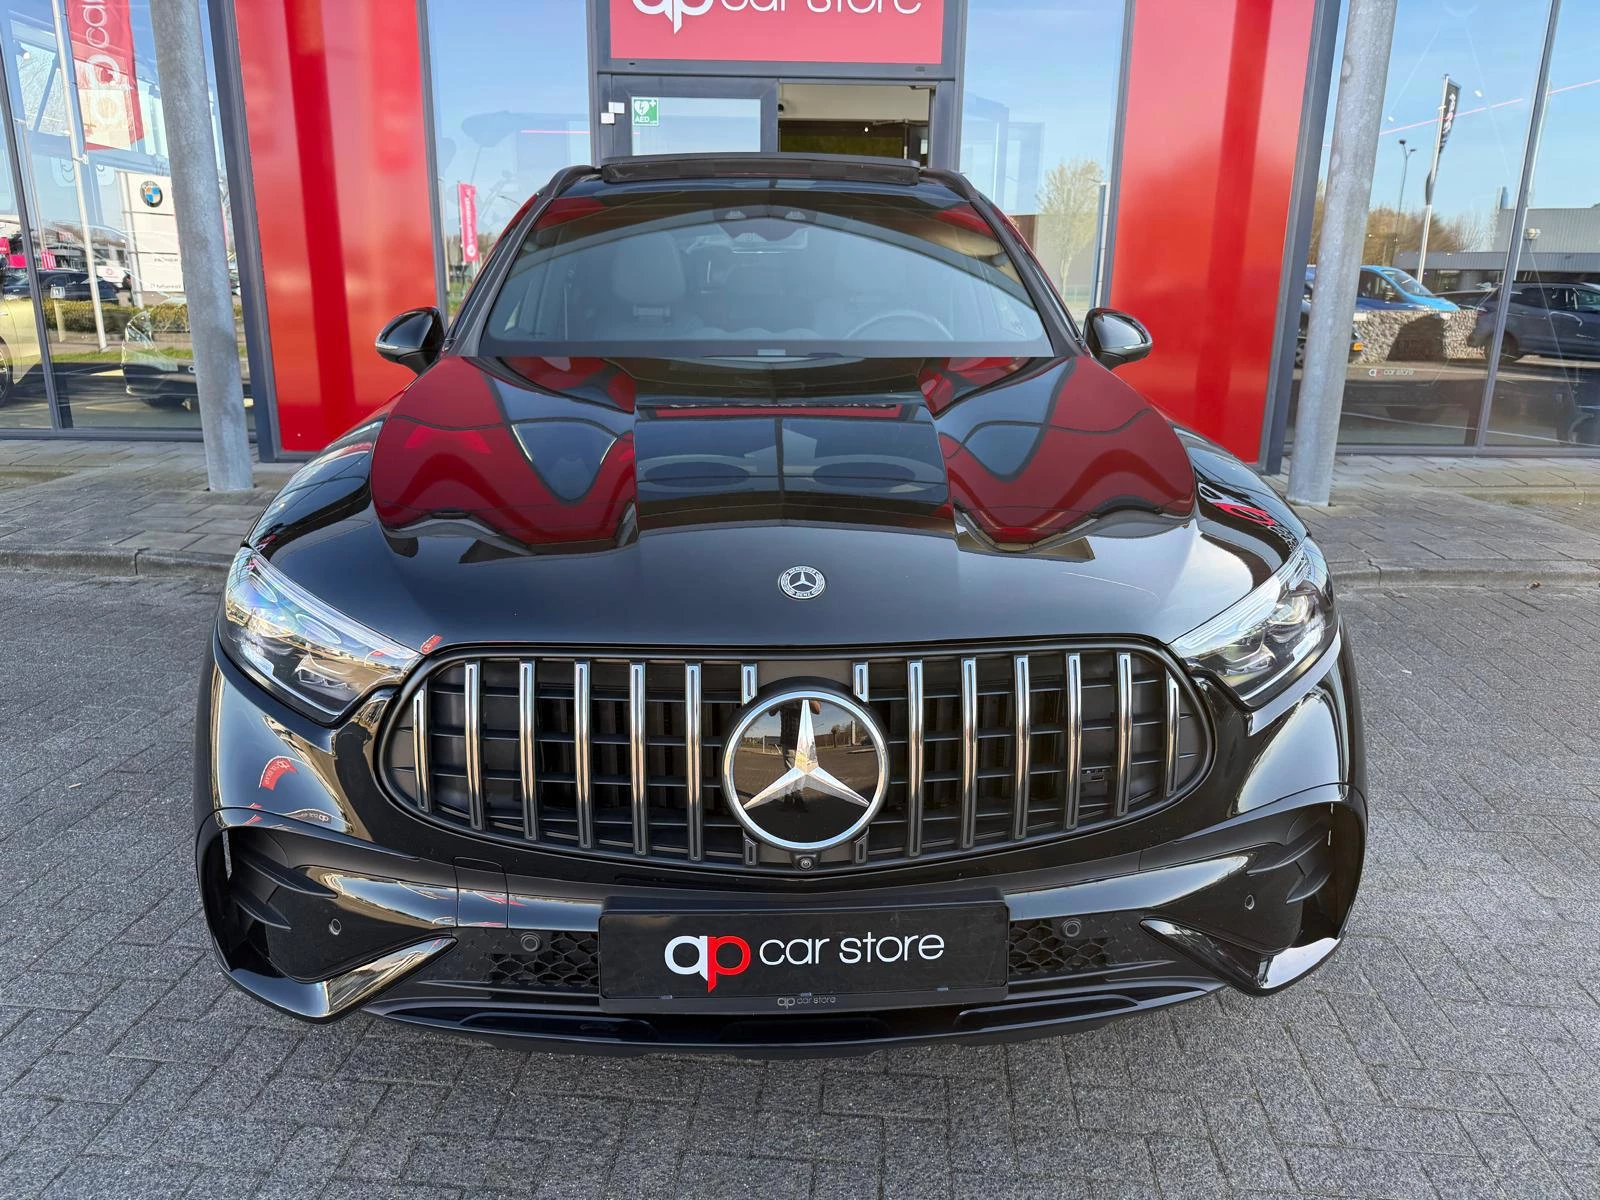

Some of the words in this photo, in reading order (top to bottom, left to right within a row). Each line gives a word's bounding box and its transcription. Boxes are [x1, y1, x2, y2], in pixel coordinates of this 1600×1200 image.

[664, 935, 751, 993] ap
[759, 937, 830, 966] car
[838, 931, 945, 965] store
[777, 997, 796, 1010] ap
[796, 997, 812, 1005] car
[813, 995, 837, 1004] store
